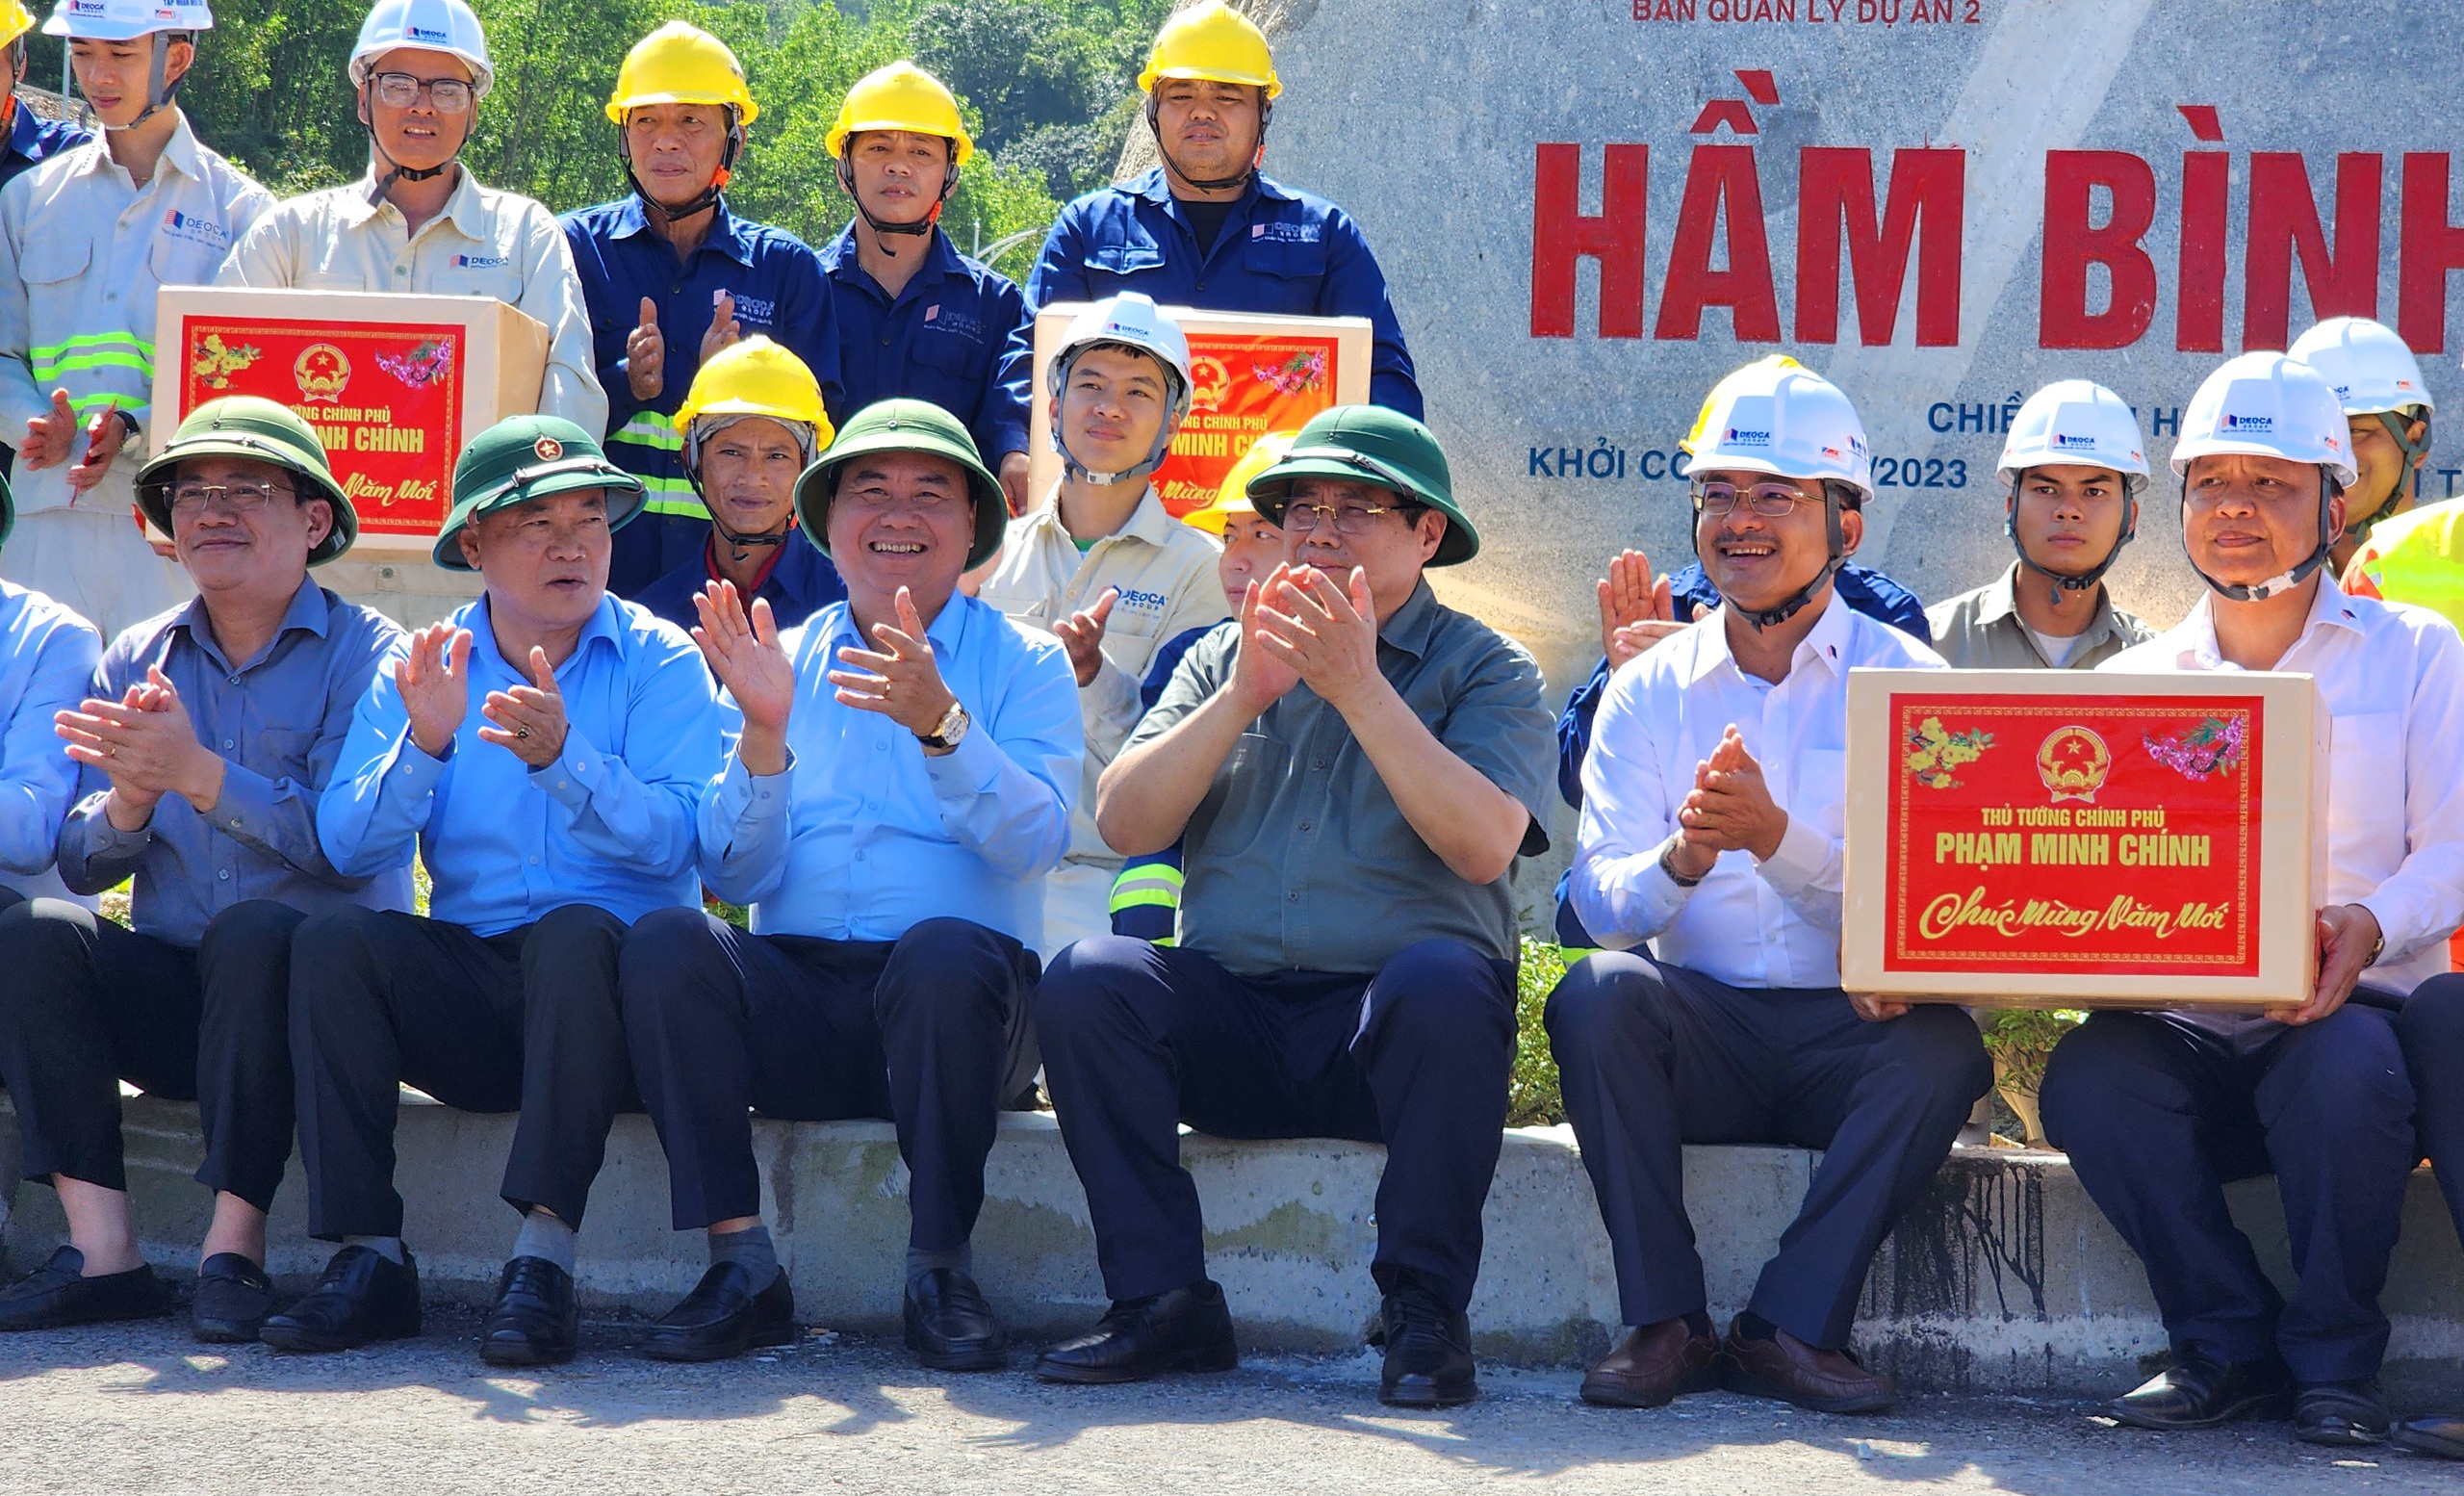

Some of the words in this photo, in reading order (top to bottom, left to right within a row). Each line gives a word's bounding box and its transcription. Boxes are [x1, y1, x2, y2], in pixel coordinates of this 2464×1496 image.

[1632, 0, 1695, 21] BAN
[1964, 0, 1980, 23] 2
[1530, 69, 1965, 347] HẦM
[2039, 105, 2464, 354] BÌNH
[187, 218, 228, 239] DEOCA
[322, 405, 362, 422] CHÍNH
[365, 405, 391, 423] PHỦ
[1202, 414, 1241, 430] CHÍNH
[2239, 417, 2273, 426] DEOCA
[354, 423, 424, 453] CHÍNH
[1171, 432, 1227, 457] MINH
[1739, 430, 1770, 439] DEOCA
[1528, 436, 1626, 479] KHỞI
[342, 472, 398, 507] Năm
[393, 479, 438, 501] Mới
[1981, 803, 2014, 826] THỦ
[2016, 806, 2071, 827] TƯỚNG
[2075, 806, 2127, 828] CHÍNH
[2131, 805, 2166, 828] PHỦ
[1936, 832, 2022, 871] PHẠM
[2031, 833, 2110, 865] MINH
[2118, 828, 2210, 866] CHÍNH
[1919, 886, 2027, 940] Chúc
[2015, 898, 2098, 938] Mừng
[2094, 894, 2177, 940] Năm
[2171, 902, 2229, 930] Mới
